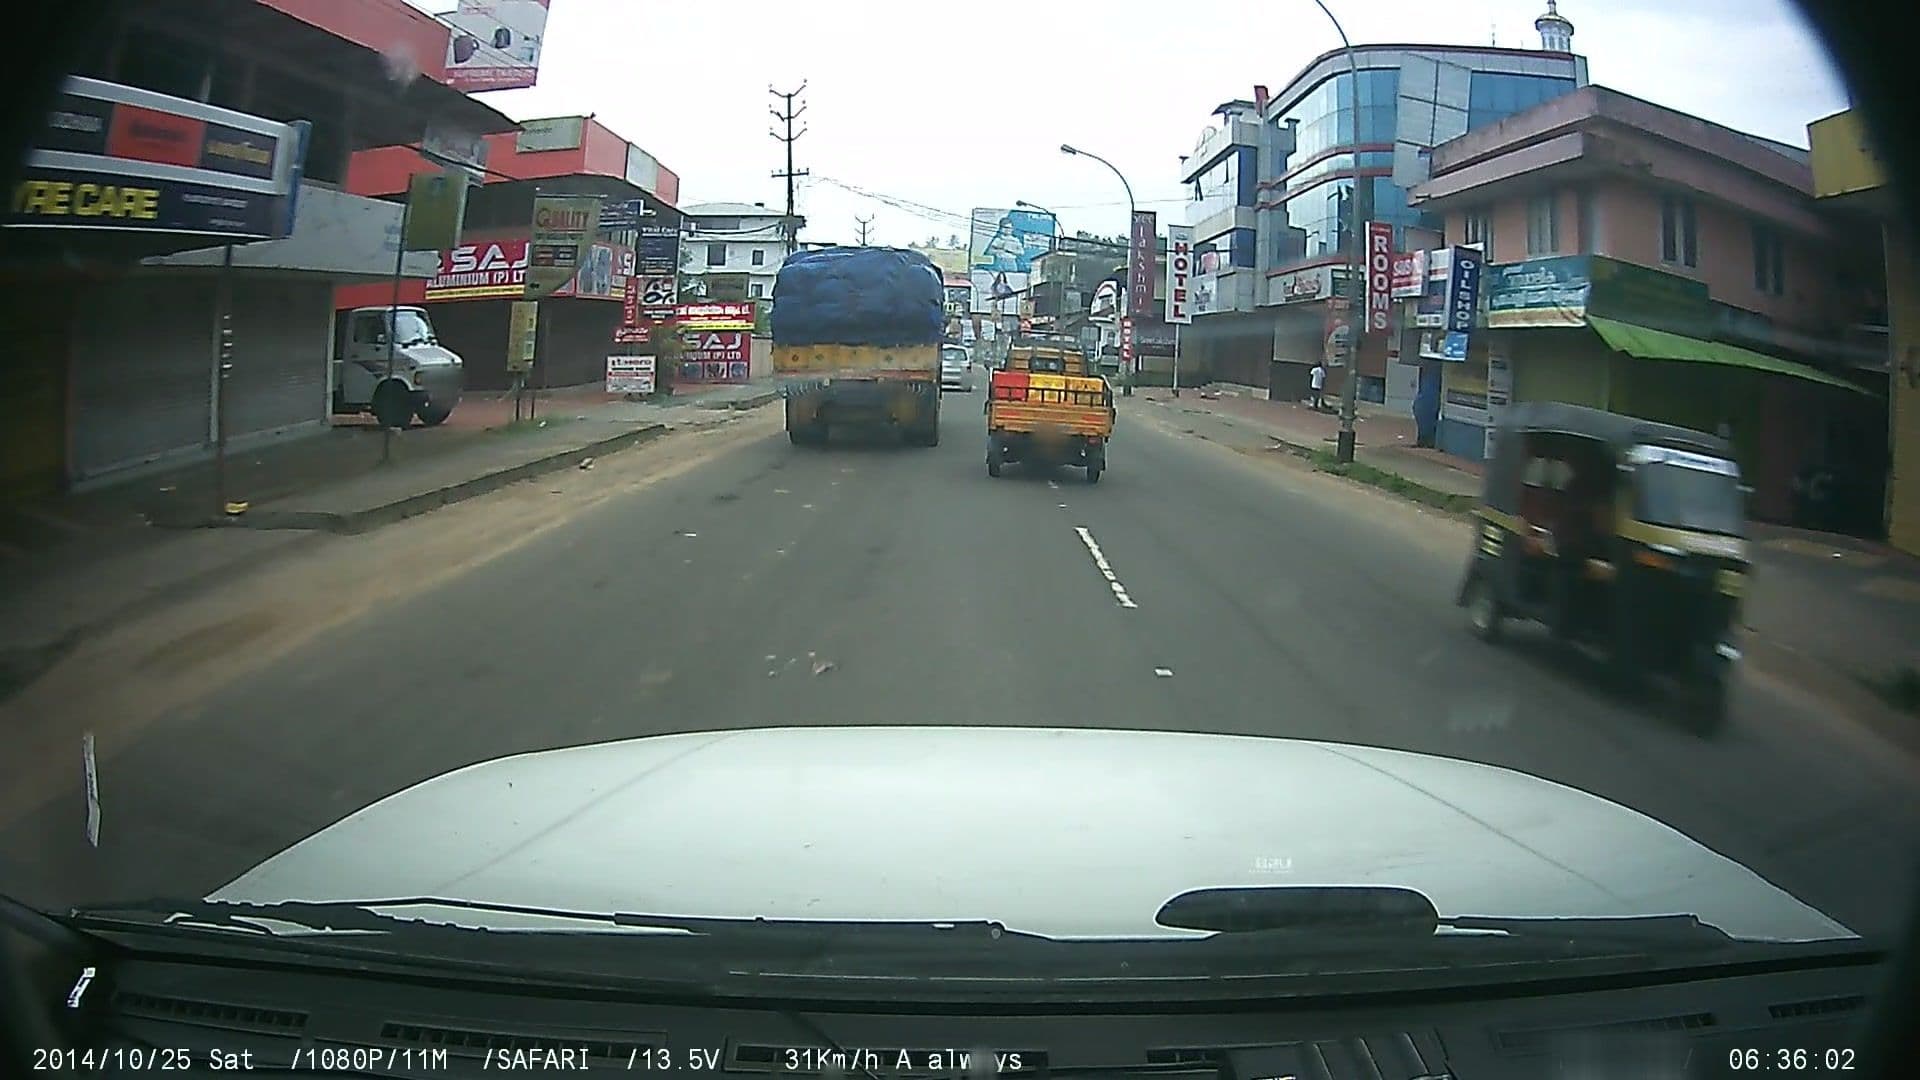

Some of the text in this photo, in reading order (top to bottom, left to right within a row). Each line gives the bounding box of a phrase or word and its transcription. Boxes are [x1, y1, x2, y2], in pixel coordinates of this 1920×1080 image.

[74, 183, 160, 219] CARE
[537, 207, 590, 233] QUALITY
[451, 241, 530, 273] SAJ
[426, 270, 526, 289] ALUMINIUM (P) LT
[1174, 241, 1188, 318] HOTEL
[1373, 235, 1389, 329] ROOMS
[682, 333, 742, 351] SAJ
[1122, 320, 1132, 358] HOTEL
[727, 351, 742, 361] LTD
